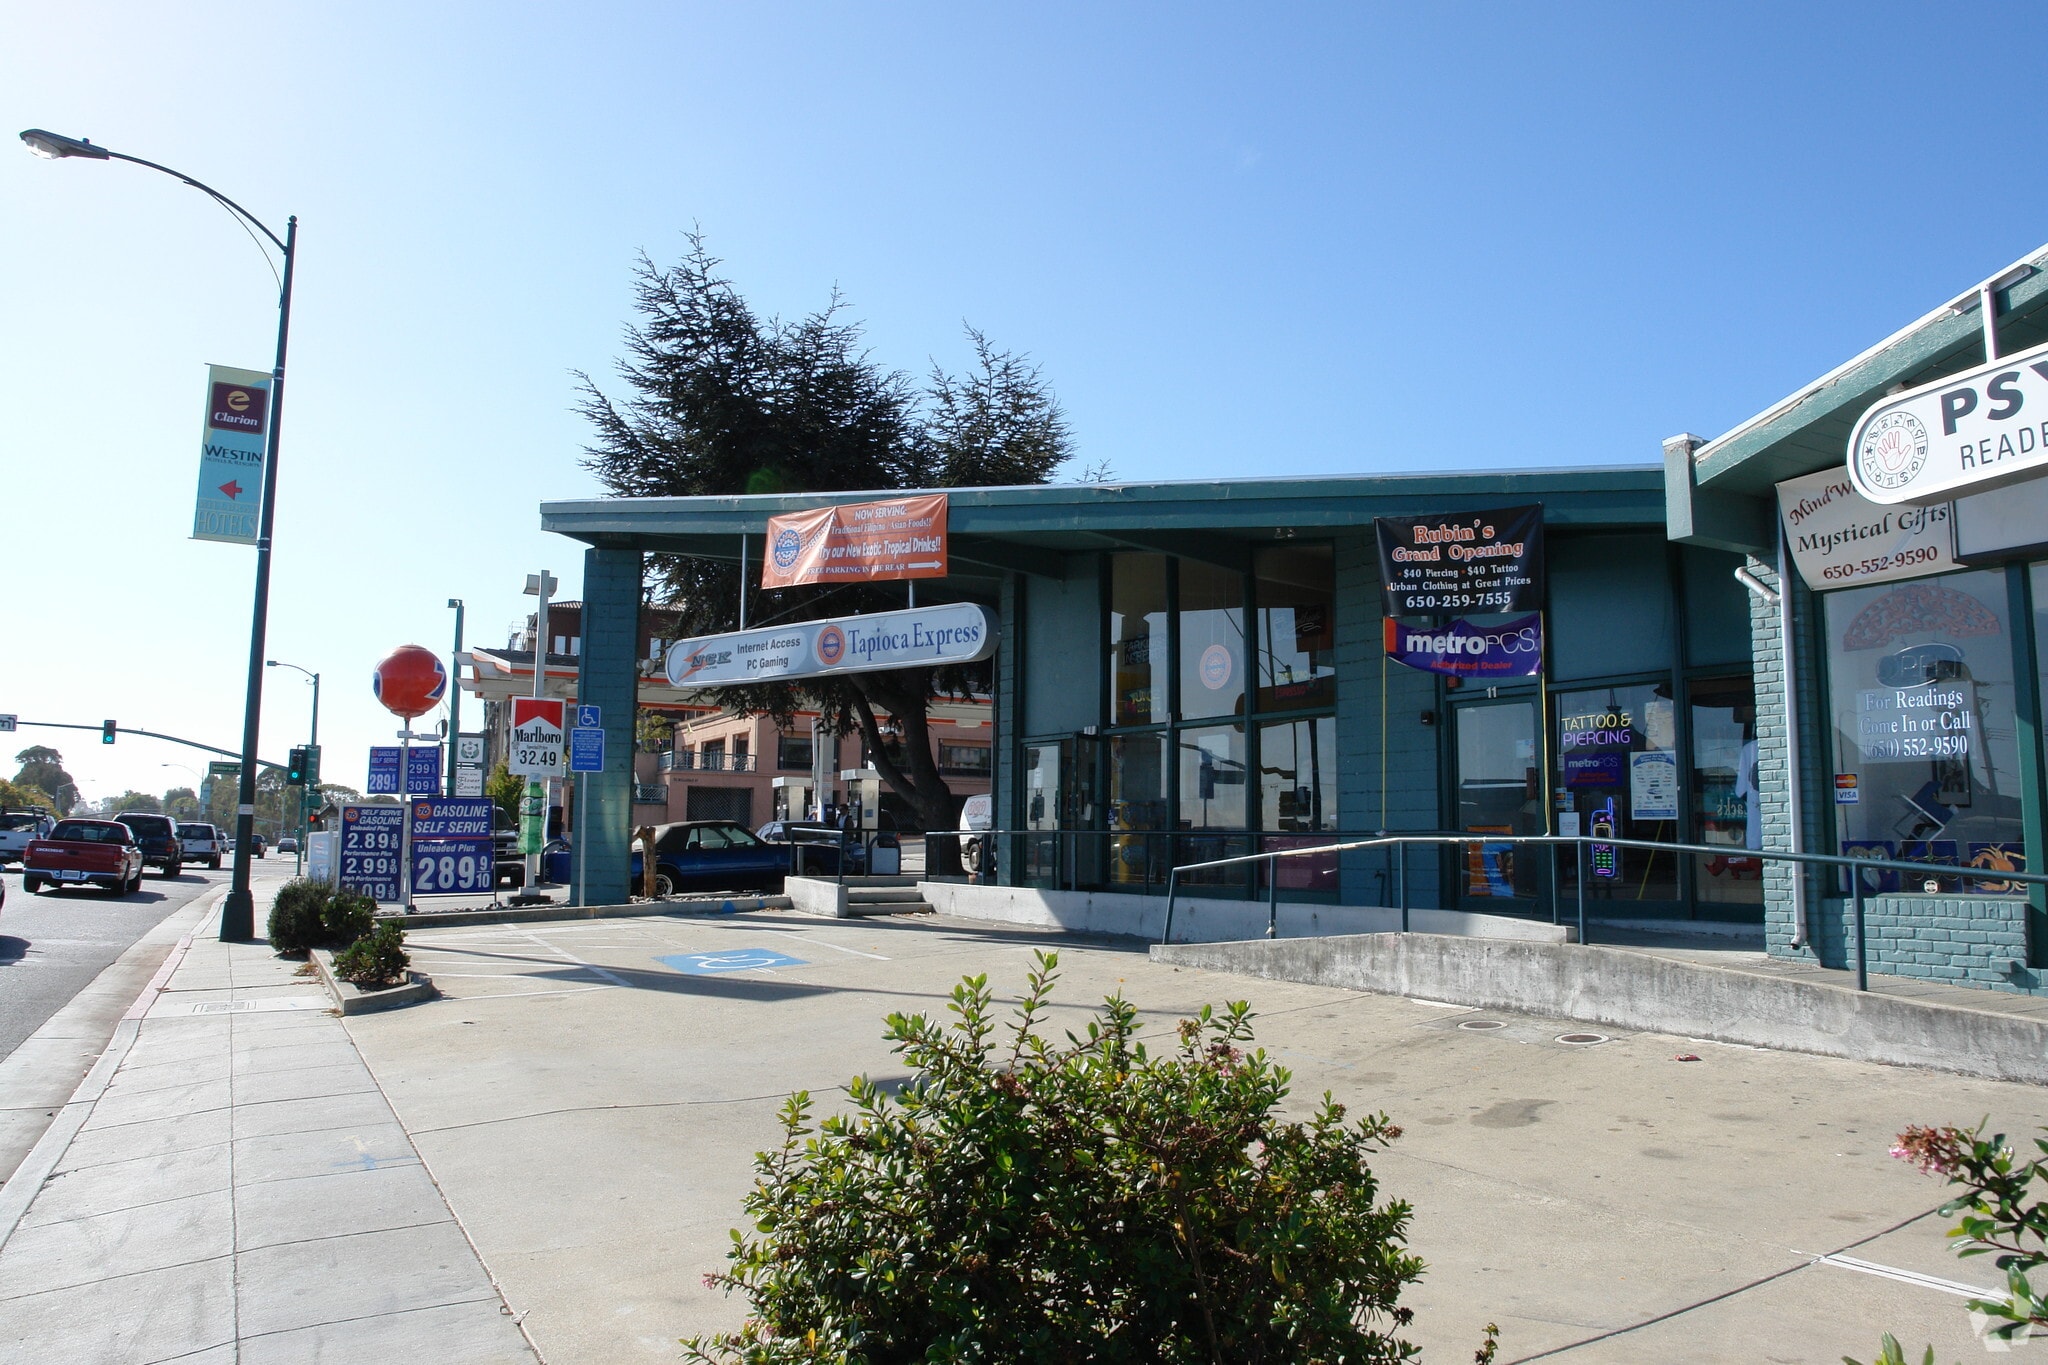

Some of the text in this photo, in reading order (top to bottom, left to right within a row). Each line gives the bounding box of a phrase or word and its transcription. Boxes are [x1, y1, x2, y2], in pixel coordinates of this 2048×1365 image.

[1940, 360, 2048, 437] PS
[214, 411, 258, 426] Clarion
[204, 443, 262, 462] WESTIN
[1789, 485, 1832, 526] Mind
[854, 509, 874, 520] NOW
[197, 511, 257, 539] HOTELS
[831, 525, 864, 534] Traditional
[864, 522, 885, 533] Filipino
[891, 520, 907, 529] Asian
[908, 517, 932, 528] Foods!!
[1413, 519, 1495, 544] Rubin's
[1797, 506, 1947, 555] Mystical Gifts
[819, 535, 941, 560] Try our New Exotic Tropical Drinks!!
[1392, 541, 1524, 563] Grand Opening
[807, 567, 824, 575] FREE
[826, 566, 861, 574] PARKING
[862, 565, 870, 573] IN
[871, 564, 884, 572] THE
[1823, 545, 1938, 579] 650-552-9590
[1403, 564, 1519, 579] $40 Piercing $40 Tattoo
[1390, 576, 1531, 592] Urban Clothing at Great Prices
[1406, 591, 1512, 608] 650-259-7555
[737, 637, 801, 654] Internet Access
[848, 627, 909, 661] Tapioca
[913, 622, 980, 655] Express
[746, 656, 789, 670] PC Gaming
[1430, 661, 1513, 670] Authorized Dealer
[1486, 686, 1497, 698] 11
[1865, 688, 1963, 711] For Readings
[1561, 713, 1617, 731] TATTOO
[1620, 712, 1632, 727] &
[1860, 710, 1971, 734] Come In or Call
[514, 726, 562, 744] Marlboro
[1563, 729, 1631, 746] PIERCING
[1864, 735, 1968, 758] (650) 552-9590
[409, 764, 430, 774] 299
[369, 774, 391, 791] 289
[408, 780, 429, 791] 309
[1839, 791, 1857, 799] VISA
[347, 811, 358, 819] 76
[417, 805, 489, 817] 76 GASOLINE
[360, 816, 403, 825] GASOLINE
[414, 821, 488, 833] SELF SERVE
[347, 832, 389, 849] 2.89
[417, 844, 476, 853] Unleaded Plus
[346, 857, 388, 874] 2.99
[416, 855, 490, 890] 289 9 10
